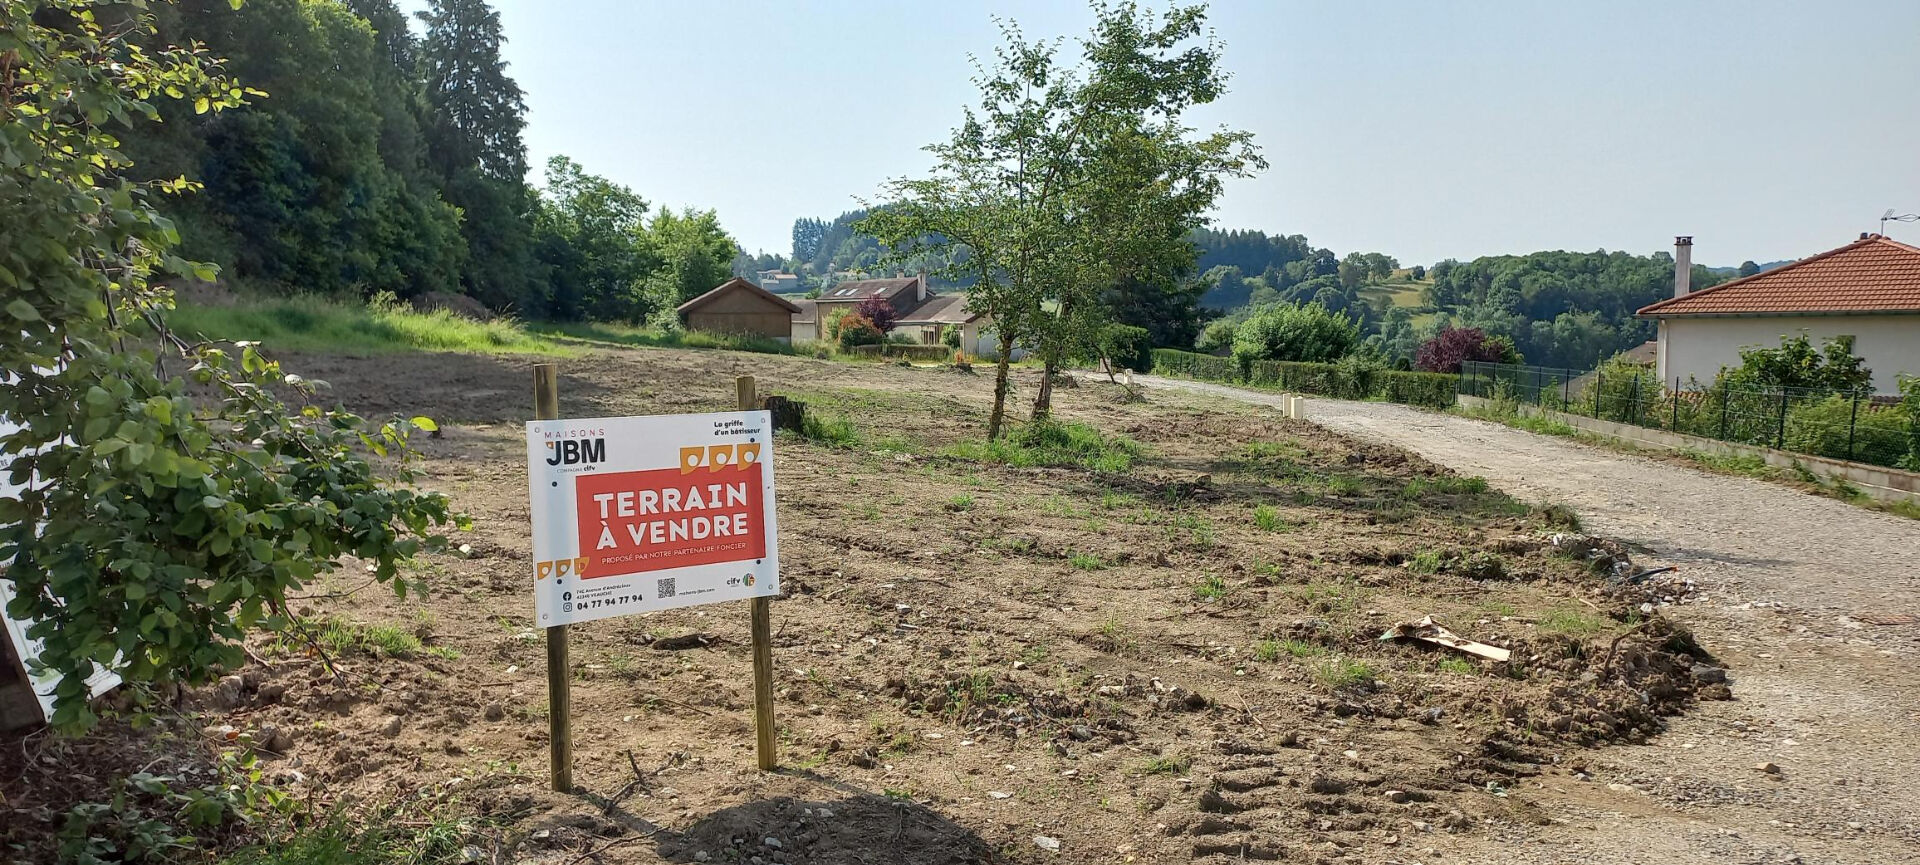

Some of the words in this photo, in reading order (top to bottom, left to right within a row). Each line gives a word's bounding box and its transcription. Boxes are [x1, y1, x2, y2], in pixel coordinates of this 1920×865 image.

[544, 428, 605, 439] MAISONS
[724, 420, 743, 428] griffe
[546, 438, 606, 466] JBM
[593, 482, 747, 519] TERRAIN
[596, 521, 618, 550] À
[626, 513, 748, 547] VENDRE
[601, 554, 633, 565] PROPOSÉ
[649, 549, 672, 559] NOTRE
[673, 546, 715, 556] PARTENAIRE
[716, 542, 747, 551] FONCIER
[577, 602, 588, 610] 04
[591, 600, 602, 609] 77
[604, 598, 616, 607] 94
[619, 596, 630, 605] 77
[632, 594, 643, 603] 94
